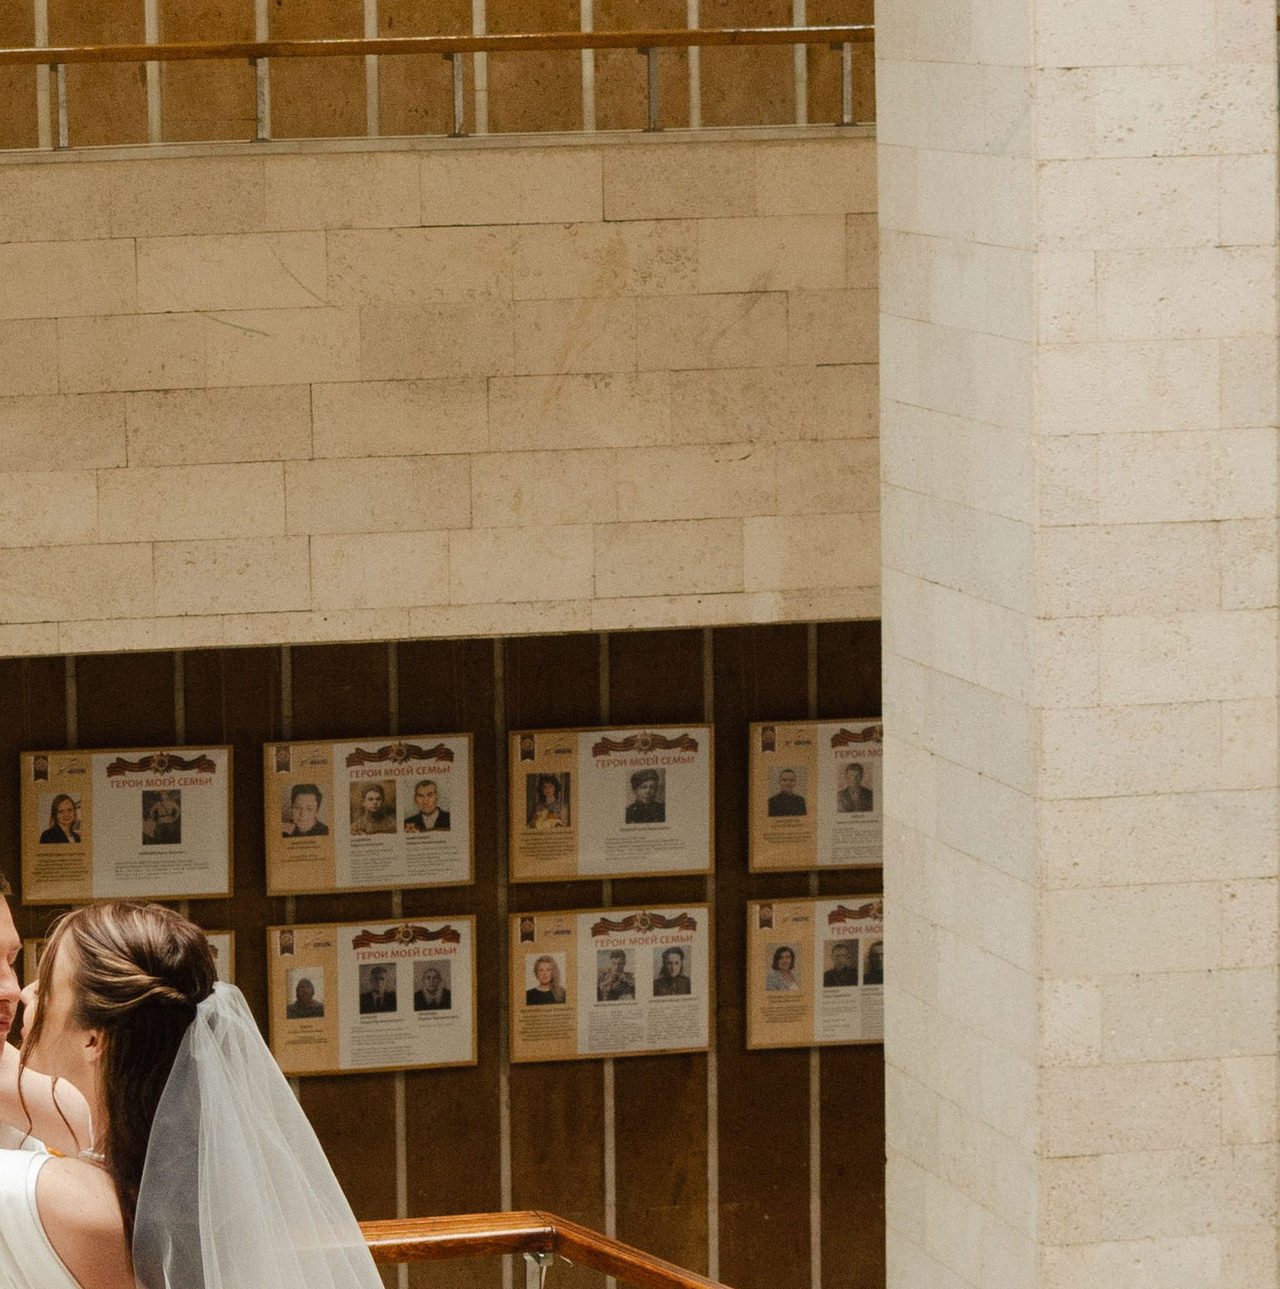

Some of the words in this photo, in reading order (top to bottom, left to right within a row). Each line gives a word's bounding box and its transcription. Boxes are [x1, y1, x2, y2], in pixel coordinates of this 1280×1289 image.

[869, 749, 883, 757] МО
[350, 769, 382, 778] ГЕРОИ
[384, 765, 413, 776] МОЕЙ
[416, 765, 451, 775] СЕМЬИ
[111, 779, 143, 788] ГЕРОИ
[146, 776, 175, 787] МОЕЙ
[178, 777, 212, 786] СЕМЬИ
[865, 925, 883, 933] МО
[595, 939, 627, 948] ГЕРОИ
[629, 935, 658, 946] МОЕЙ
[660, 935, 693, 944] СЕМЬИ
[357, 951, 388, 960] ГЕРОИ
[391, 947, 420, 958] МОЕЙ
[422, 947, 457, 956] СЕМЬИ
